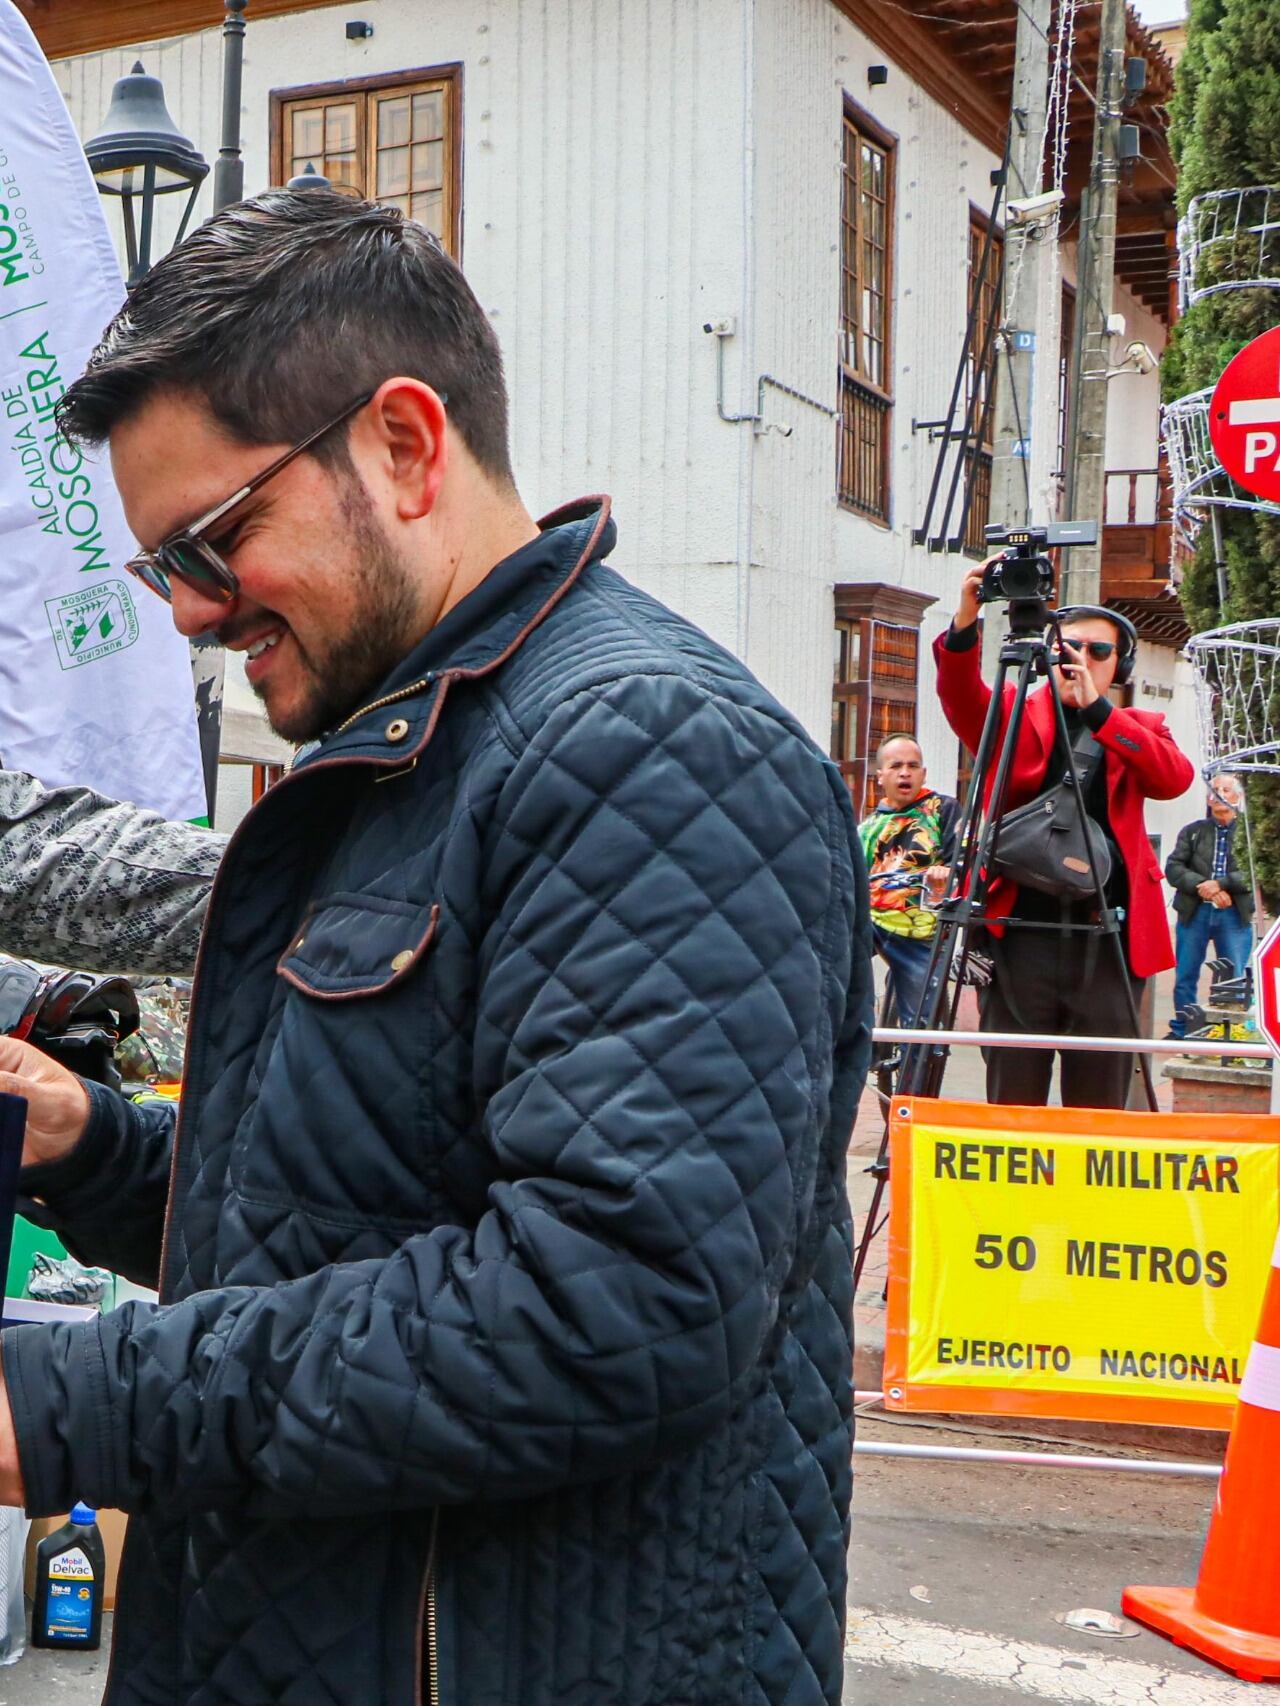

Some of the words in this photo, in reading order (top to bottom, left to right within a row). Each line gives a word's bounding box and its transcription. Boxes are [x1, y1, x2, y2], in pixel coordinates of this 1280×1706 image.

[2, 173, 21, 199] DE
[14, 207, 45, 275] CAMPO
[1, 385, 29, 418] DE
[1244, 431, 1280, 474] P
[11, 422, 63, 535] ALCALDÍA
[61, 585, 109, 607] MOSQUERA
[76, 640, 122, 662] MUNICIPIO
[934, 1141, 1055, 1186] RETEN
[1085, 1148, 1240, 1193] MILITAR
[974, 1233, 1037, 1272] 50
[1065, 1239, 1228, 1289] METROS
[937, 1337, 1071, 1372] EJERCITO
[1100, 1349, 1242, 1385] NACIONAL
[52, 1563, 90, 1575] Delvac
[61, 1557, 83, 1565] Mobil
